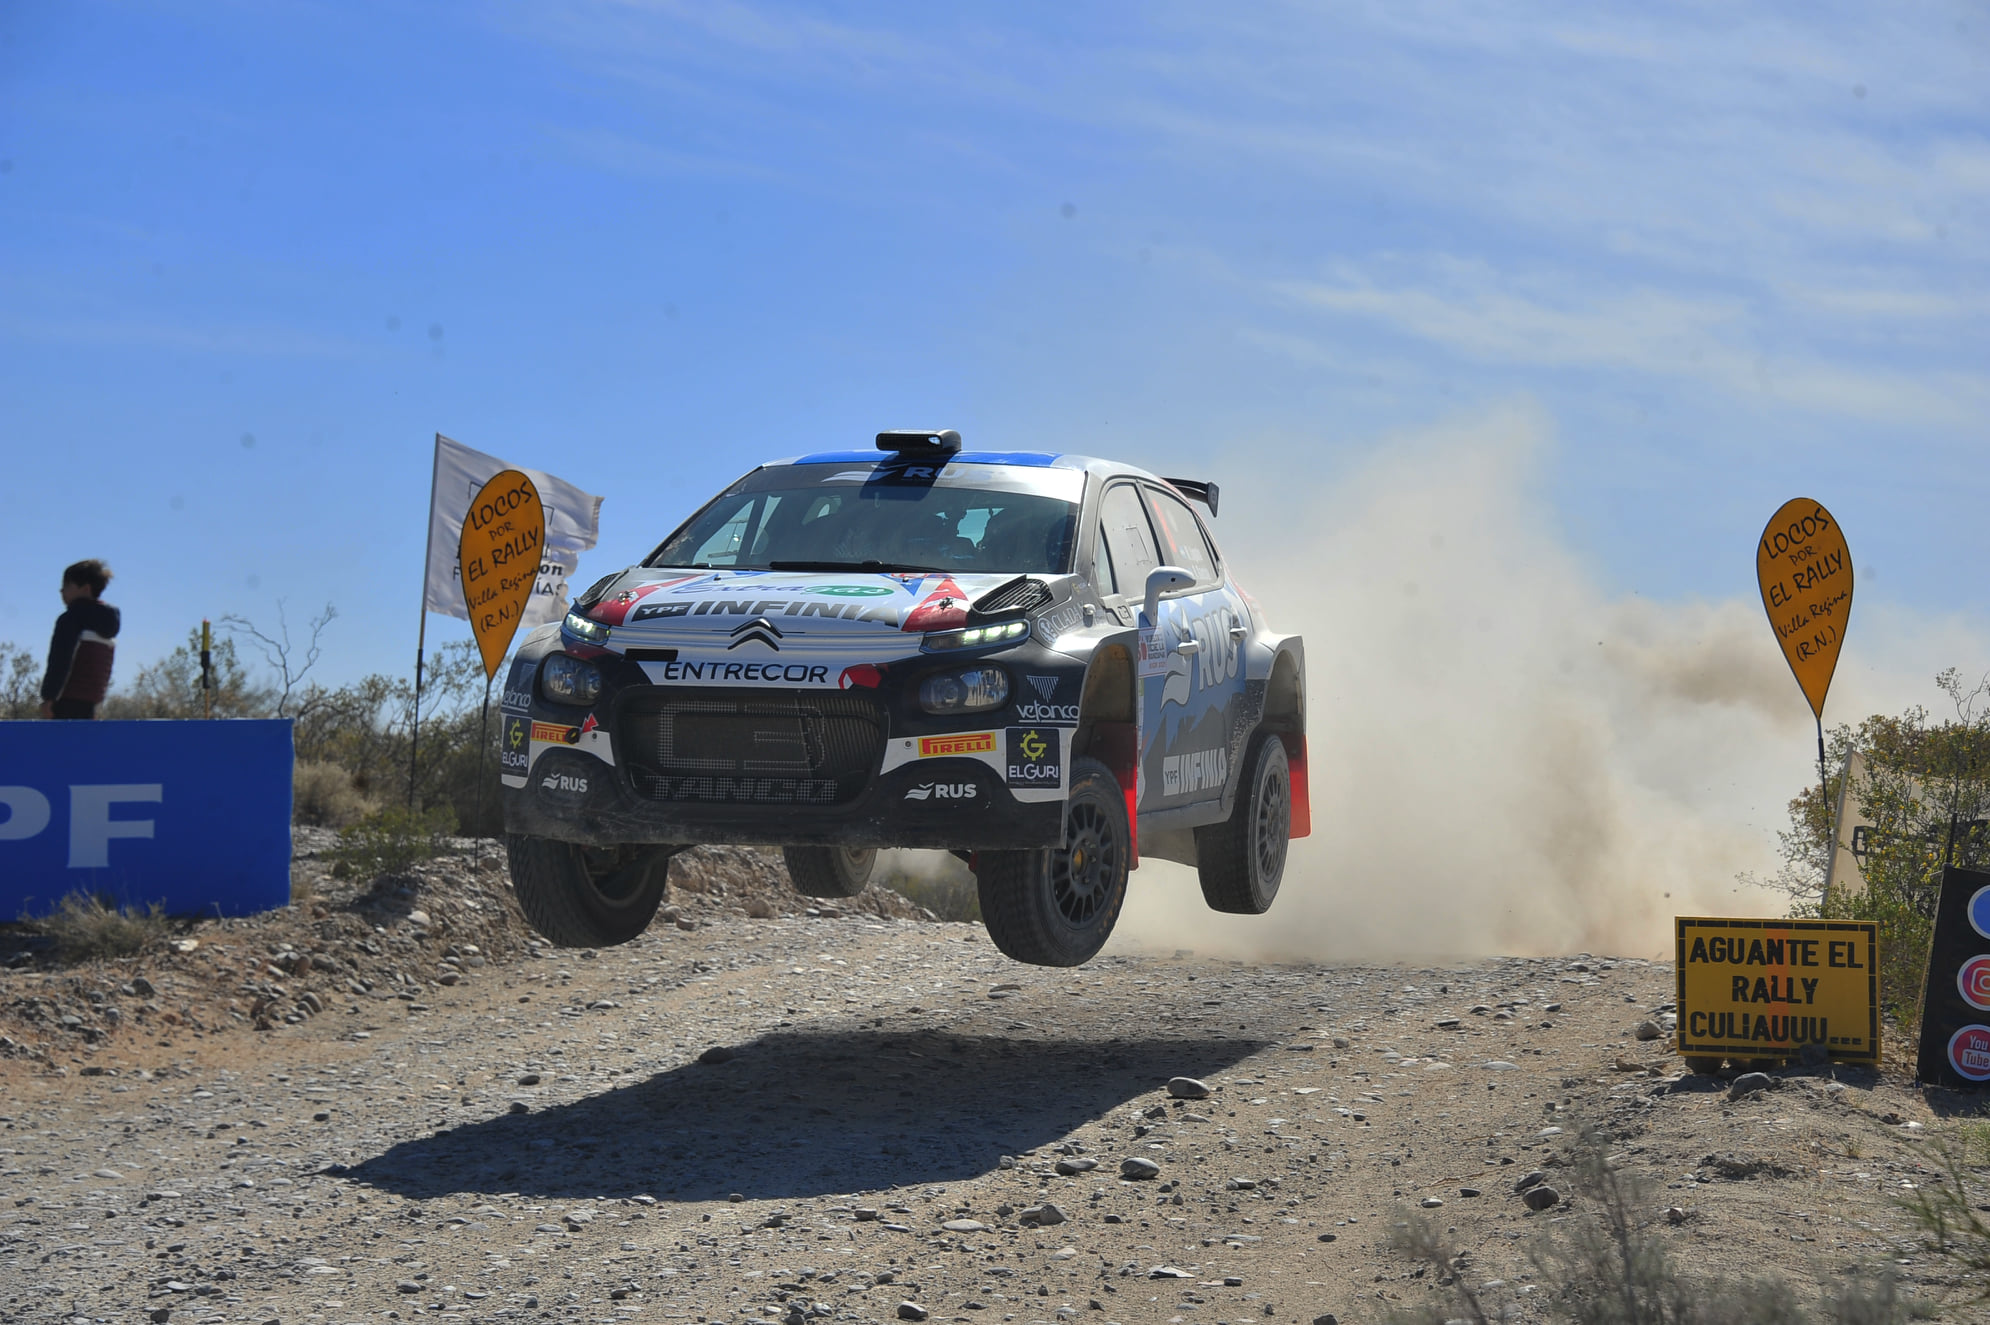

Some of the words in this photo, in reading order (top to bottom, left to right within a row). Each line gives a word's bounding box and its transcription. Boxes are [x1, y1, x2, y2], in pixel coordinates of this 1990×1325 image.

[903, 466, 992, 481] RUS
[471, 481, 534, 531] LOCOS
[489, 521, 515, 541] POR
[1764, 508, 1830, 559] LOCOS
[468, 561, 488, 582] EL
[493, 526, 539, 569] RALLY
[1789, 546, 1818, 566] POR
[468, 587, 498, 611] Villa
[500, 567, 537, 592] Regina
[1769, 582, 1792, 608] EL
[1792, 549, 1843, 593] RALLY
[641, 605, 686, 616] YPF
[694, 600, 899, 628] INFINIA
[1778, 614, 1810, 639] Villa
[1809, 590, 1848, 617] Regina
[1193, 606, 1240, 692] RUS
[663, 661, 829, 684] ENTRECOR
[532, 722, 568, 743] PIREL
[922, 733, 992, 755] PIRELLI
[560, 775, 588, 793] RUS
[1164, 769, 1178, 785] YPF
[1180, 747, 1228, 794] INFINIA
[935, 783, 977, 799] RUS
[1689, 936, 1819, 967] AGUANTE
[1828, 941, 1864, 968] EL
[1731, 975, 1819, 1005] RALLY
[1969, 1035, 1989, 1051] You
[1965, 1051, 1989, 1067] Tube
